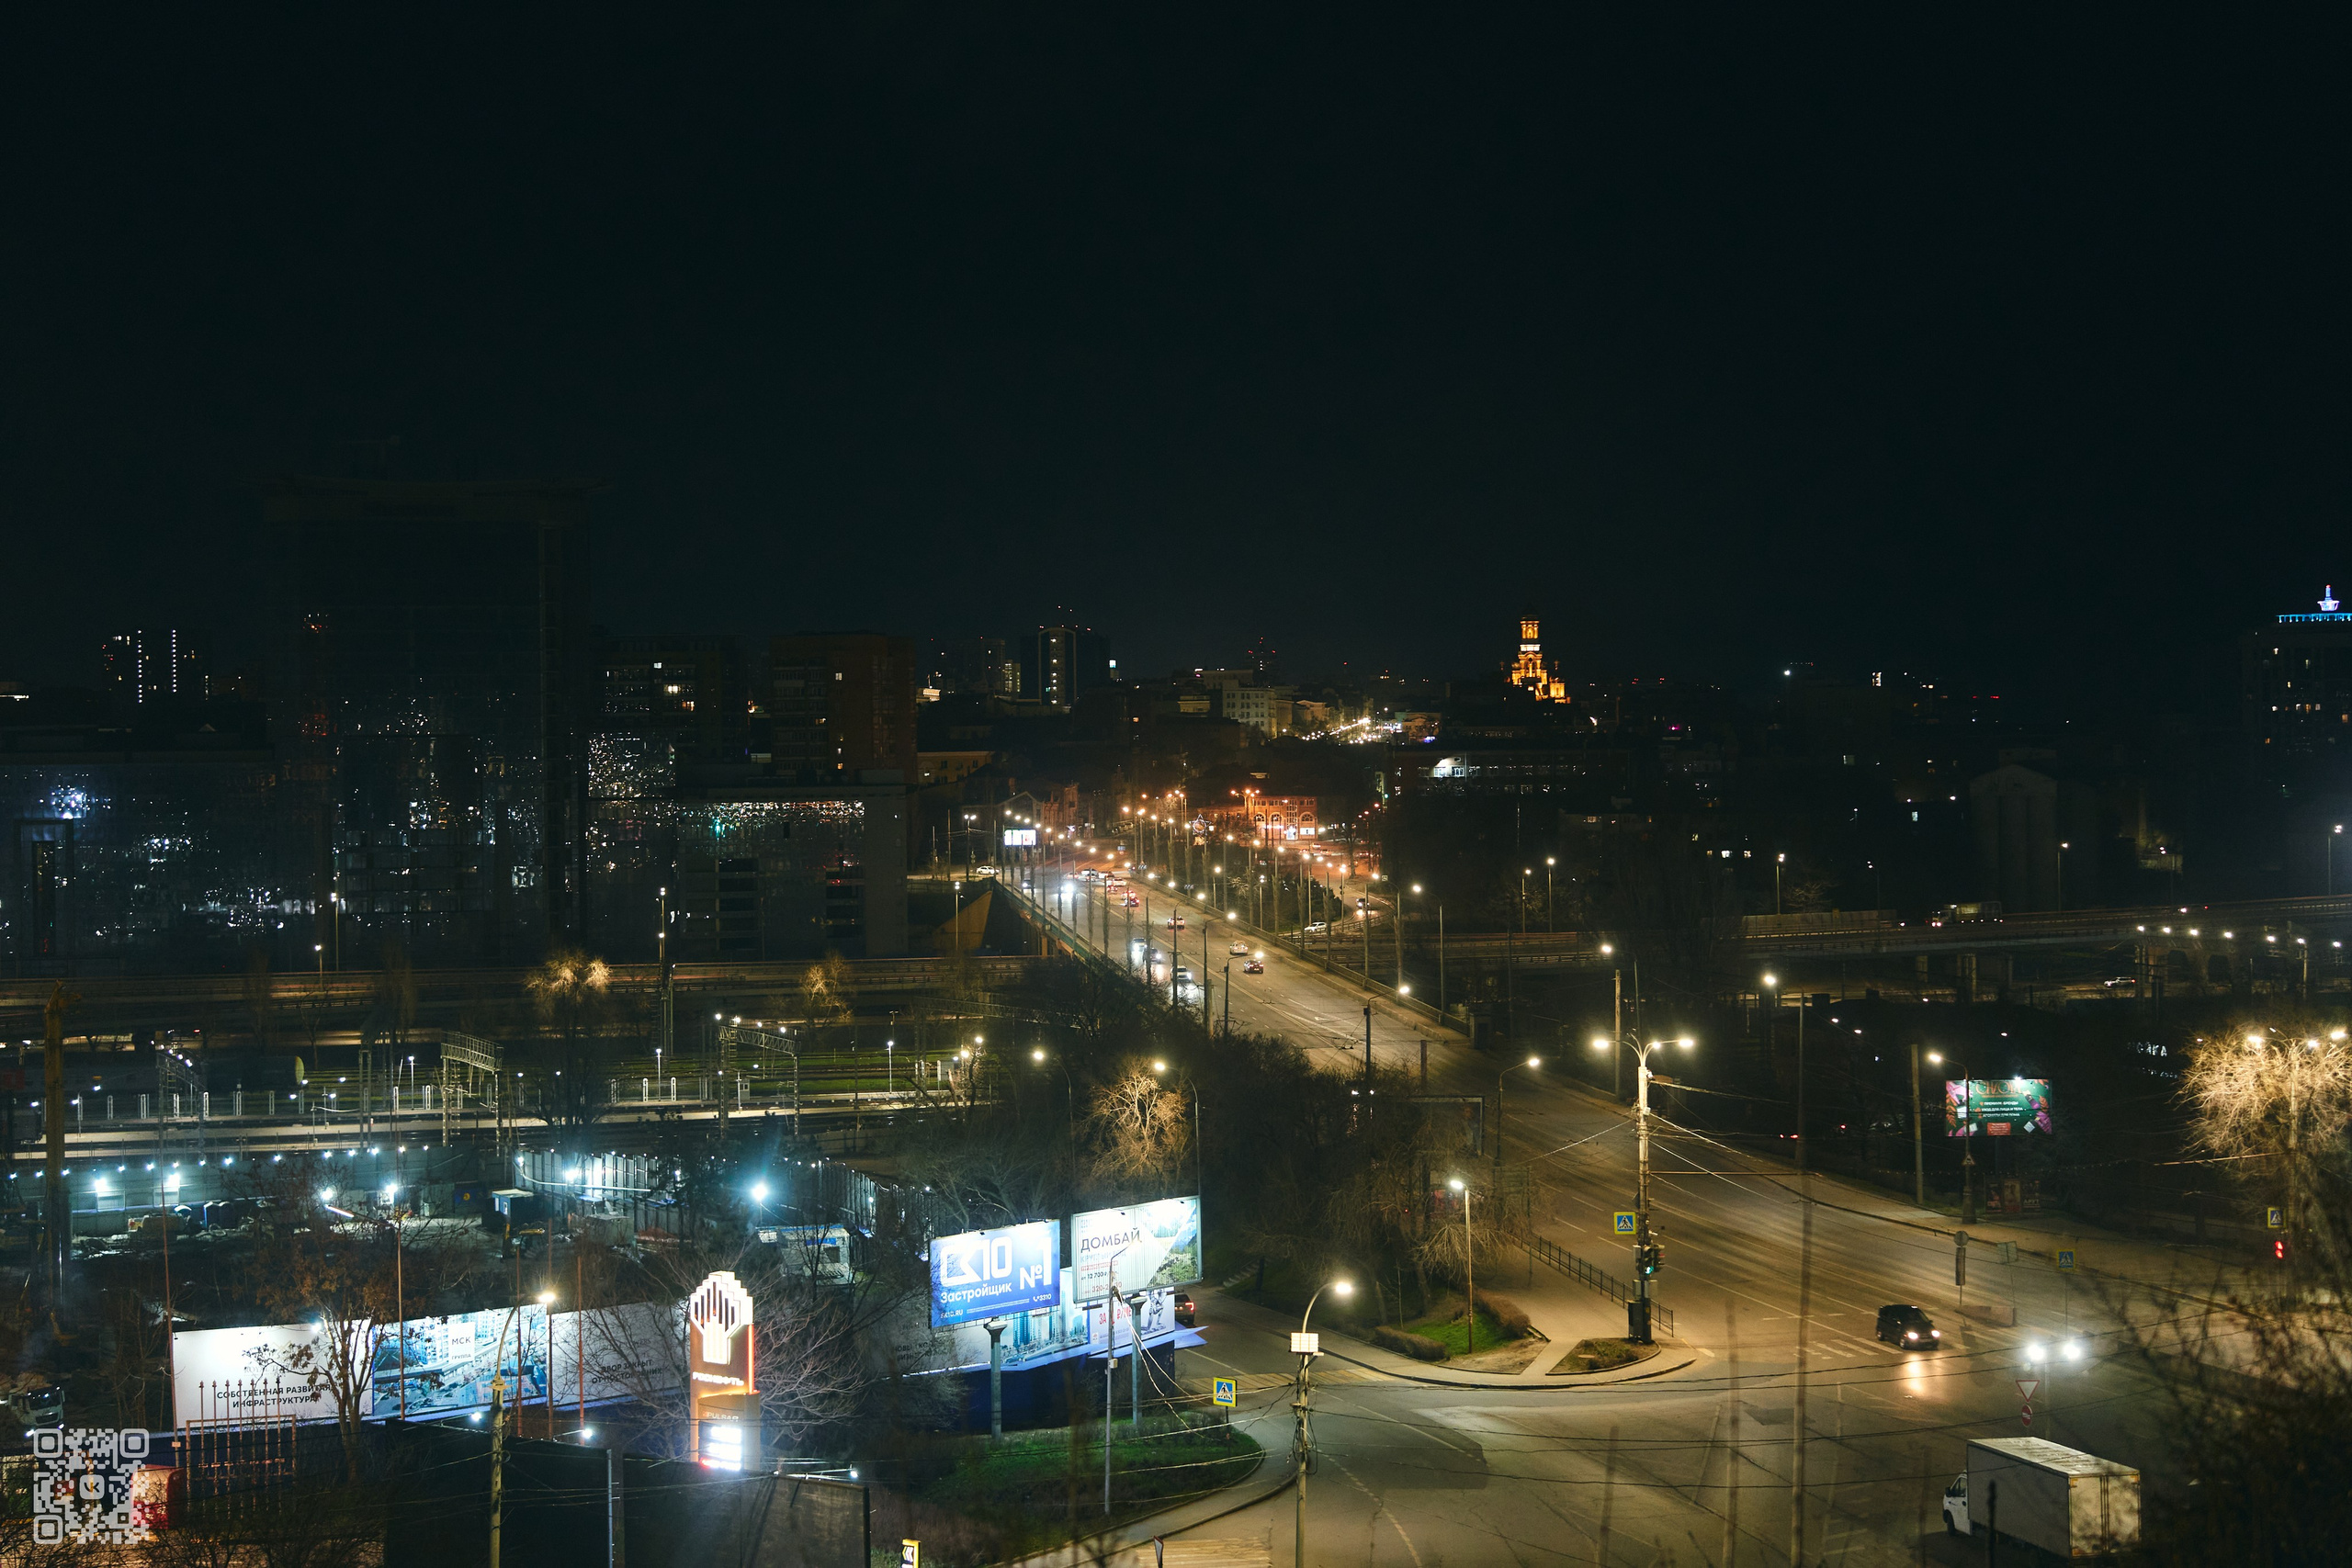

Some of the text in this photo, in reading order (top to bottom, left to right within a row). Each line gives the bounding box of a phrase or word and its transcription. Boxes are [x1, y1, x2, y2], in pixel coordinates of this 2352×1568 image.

[1080, 1227, 1140, 1254] ДОМБАЙ
[1019, 1236, 1052, 1290] №1
[940, 1282, 1012, 1303] Застройщик
[1099, 1312, 1107, 1325] ЗА
[451, 1337, 471, 1346] МСК
[217, 1388, 284, 1399] СОБСТВЕННАЯ
[232, 1395, 317, 1408] ИНФРАСТРУКТУРА
[707, 1412, 740, 1422] PULSAR
